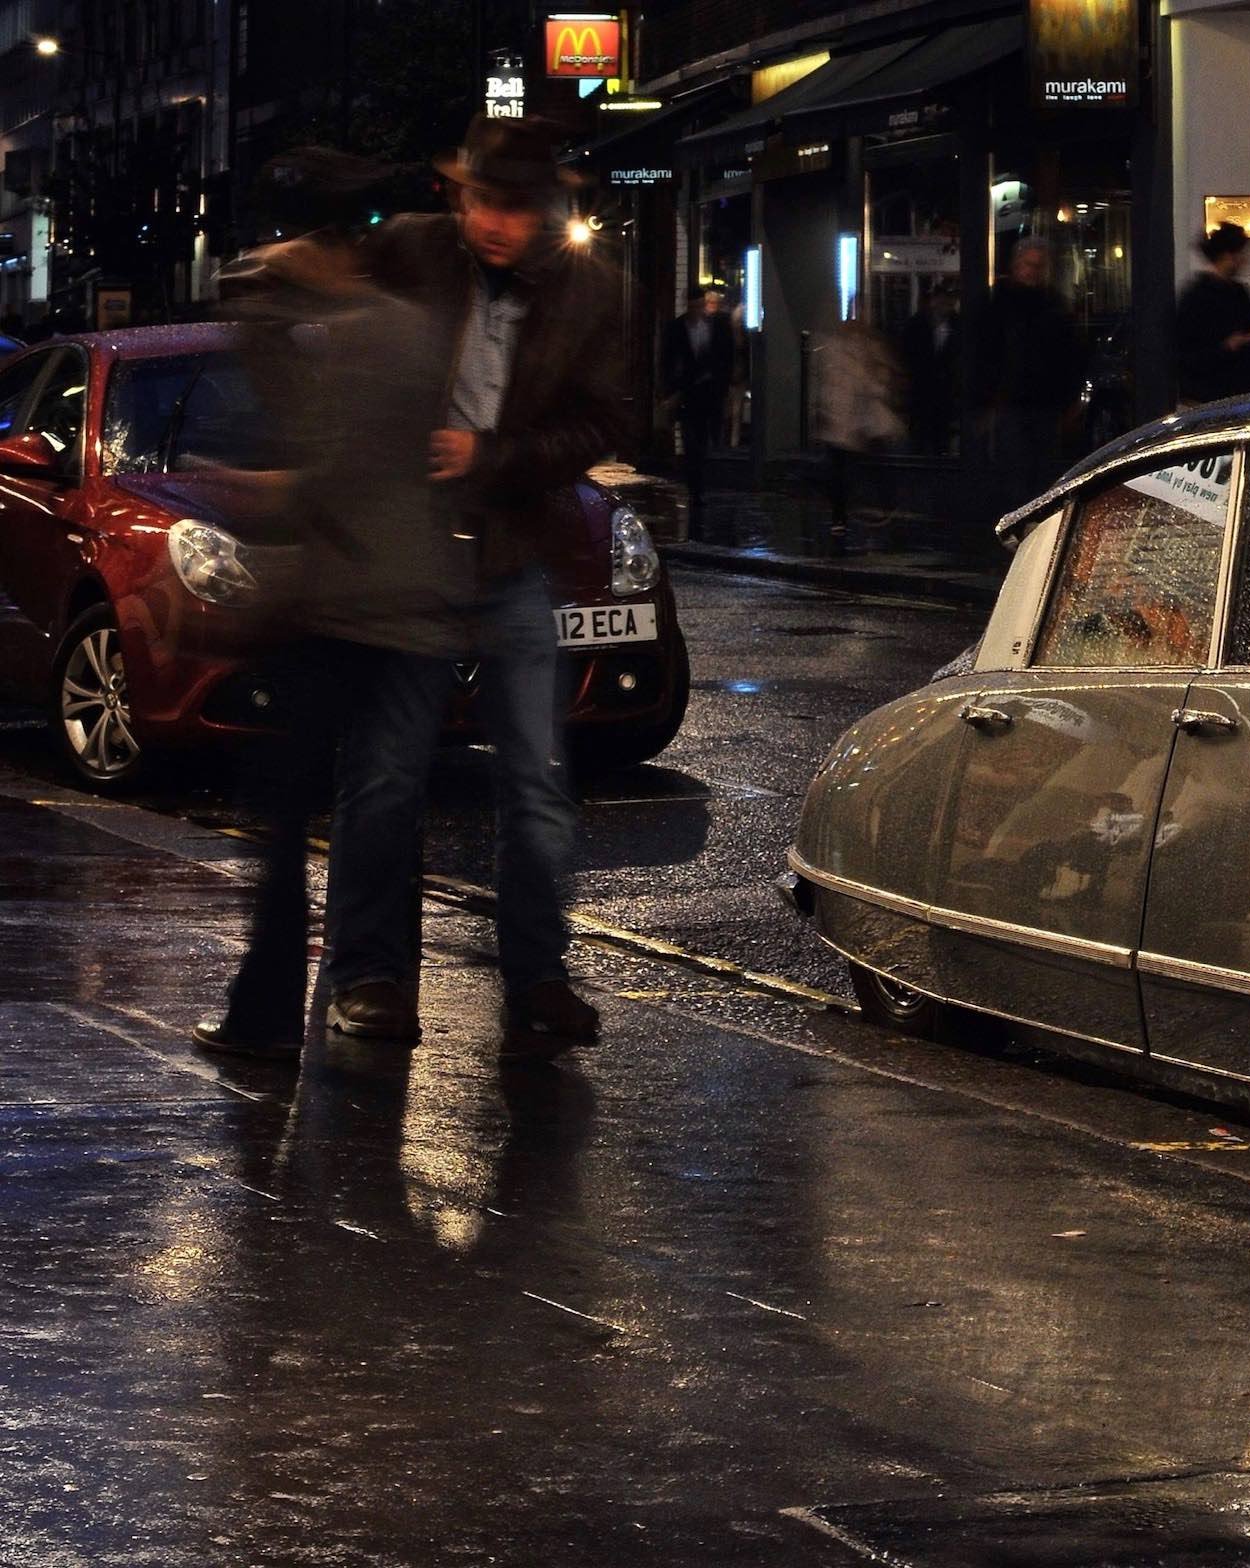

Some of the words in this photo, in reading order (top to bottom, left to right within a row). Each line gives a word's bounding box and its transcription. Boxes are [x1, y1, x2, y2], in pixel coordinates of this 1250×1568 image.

[485, 77, 525, 98] Bell
[1045, 78, 1127, 94] murakami
[610, 167, 673, 179] murakami
[561, 612, 585, 640] 12
[592, 609, 638, 638] ECA
